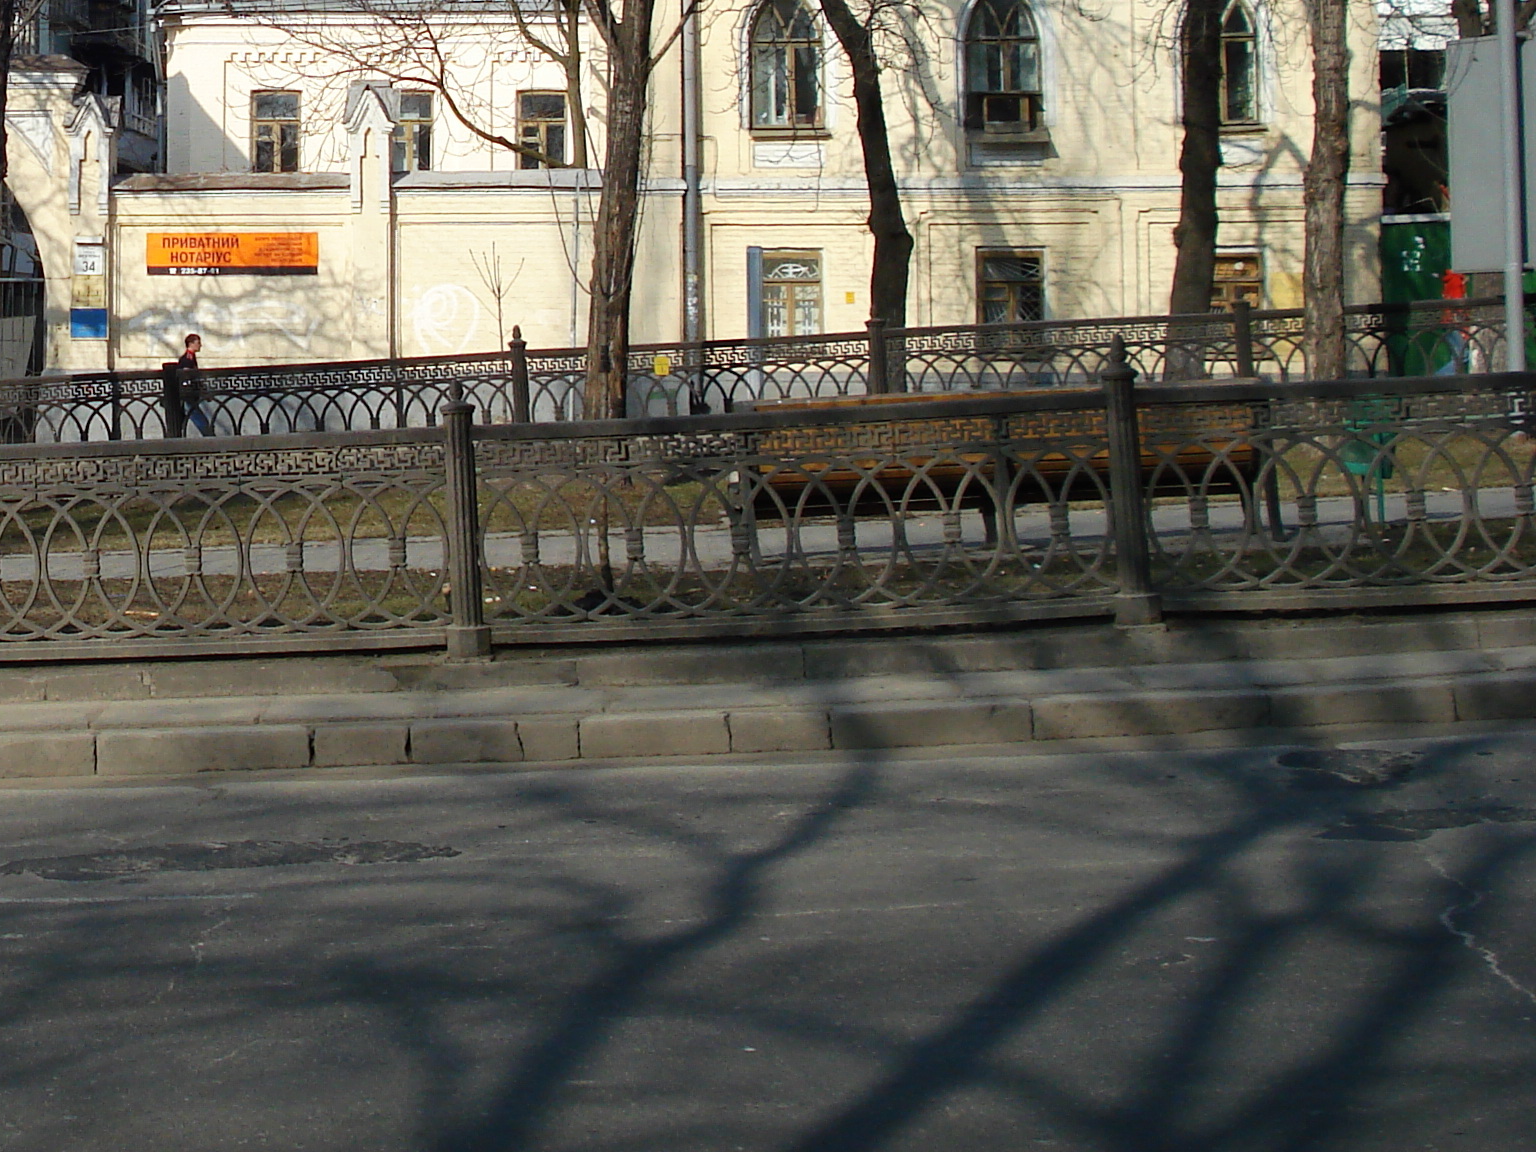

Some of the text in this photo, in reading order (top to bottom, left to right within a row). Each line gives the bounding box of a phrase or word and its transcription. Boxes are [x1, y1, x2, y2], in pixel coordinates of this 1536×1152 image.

[162, 235, 239, 249] ПРИВАТНИЙ
[170, 251, 232, 263] НОТАРІУС
[82, 260, 95, 272] 34
